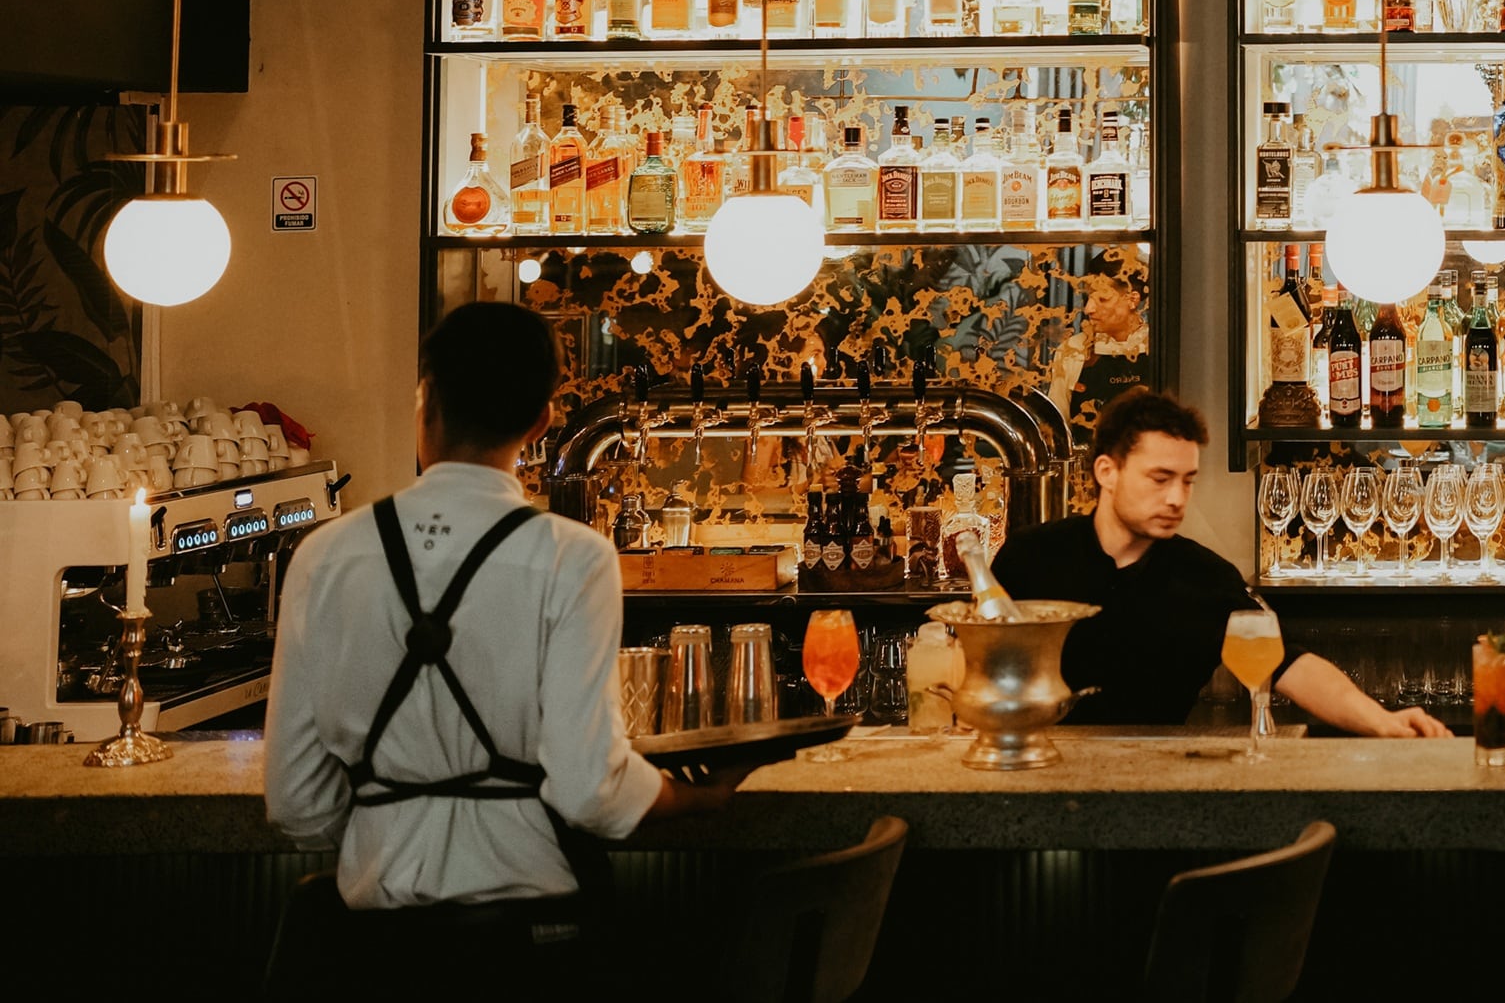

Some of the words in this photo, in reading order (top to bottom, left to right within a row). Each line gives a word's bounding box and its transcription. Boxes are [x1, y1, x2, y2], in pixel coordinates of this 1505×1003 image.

[1003, 173, 1014, 184] JIM
[1014, 171, 1032, 184] BEAM
[1004, 197, 1029, 205] BOURBON
[1371, 354, 1403, 365] CARPANO
[1418, 355, 1450, 365] CARPANO
[1331, 361, 1354, 371] PUNT
